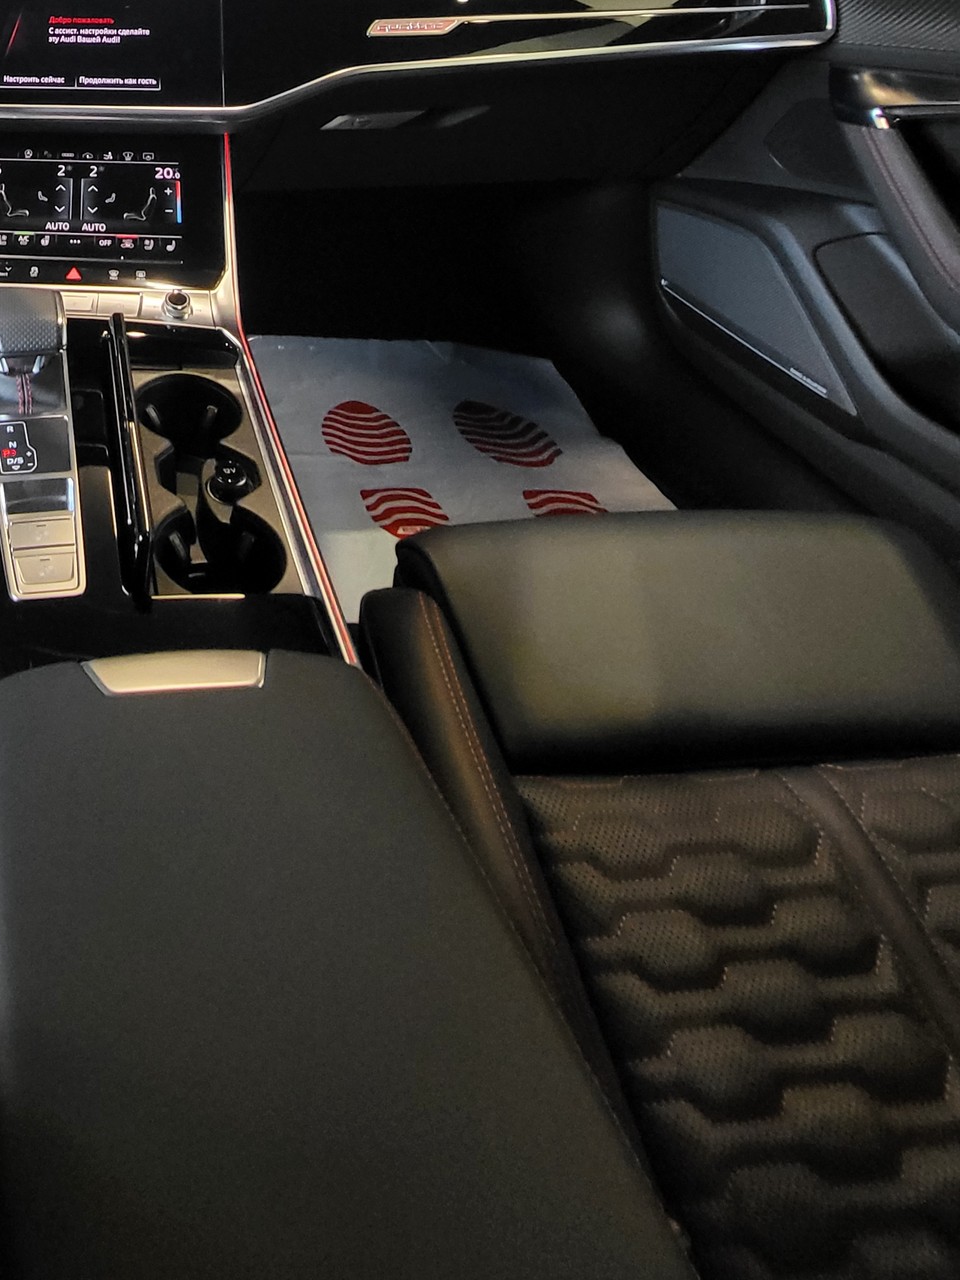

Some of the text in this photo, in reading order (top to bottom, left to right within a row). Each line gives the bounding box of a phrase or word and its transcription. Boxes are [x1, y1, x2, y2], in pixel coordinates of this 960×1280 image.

[49, 16, 72, 24] Добро
[80, 27, 116, 36] настройки
[118, 27, 150, 36] сделайте
[60, 35, 77, 43] Audi
[77, 35, 101, 43] Вашей
[3, 75, 65, 84] Настроить сейчас
[79, 76, 124, 86] Продолжить
[138, 78, 157, 86] гость
[57, 164, 66, 177] 2
[89, 165, 98, 177] 2
[45, 222, 70, 231] AUTO
[81, 223, 106, 232] AUTO
[6, 425, 14, 433] R
[8, 441, 17, 449] N
[6, 456, 24, 466] D/S
